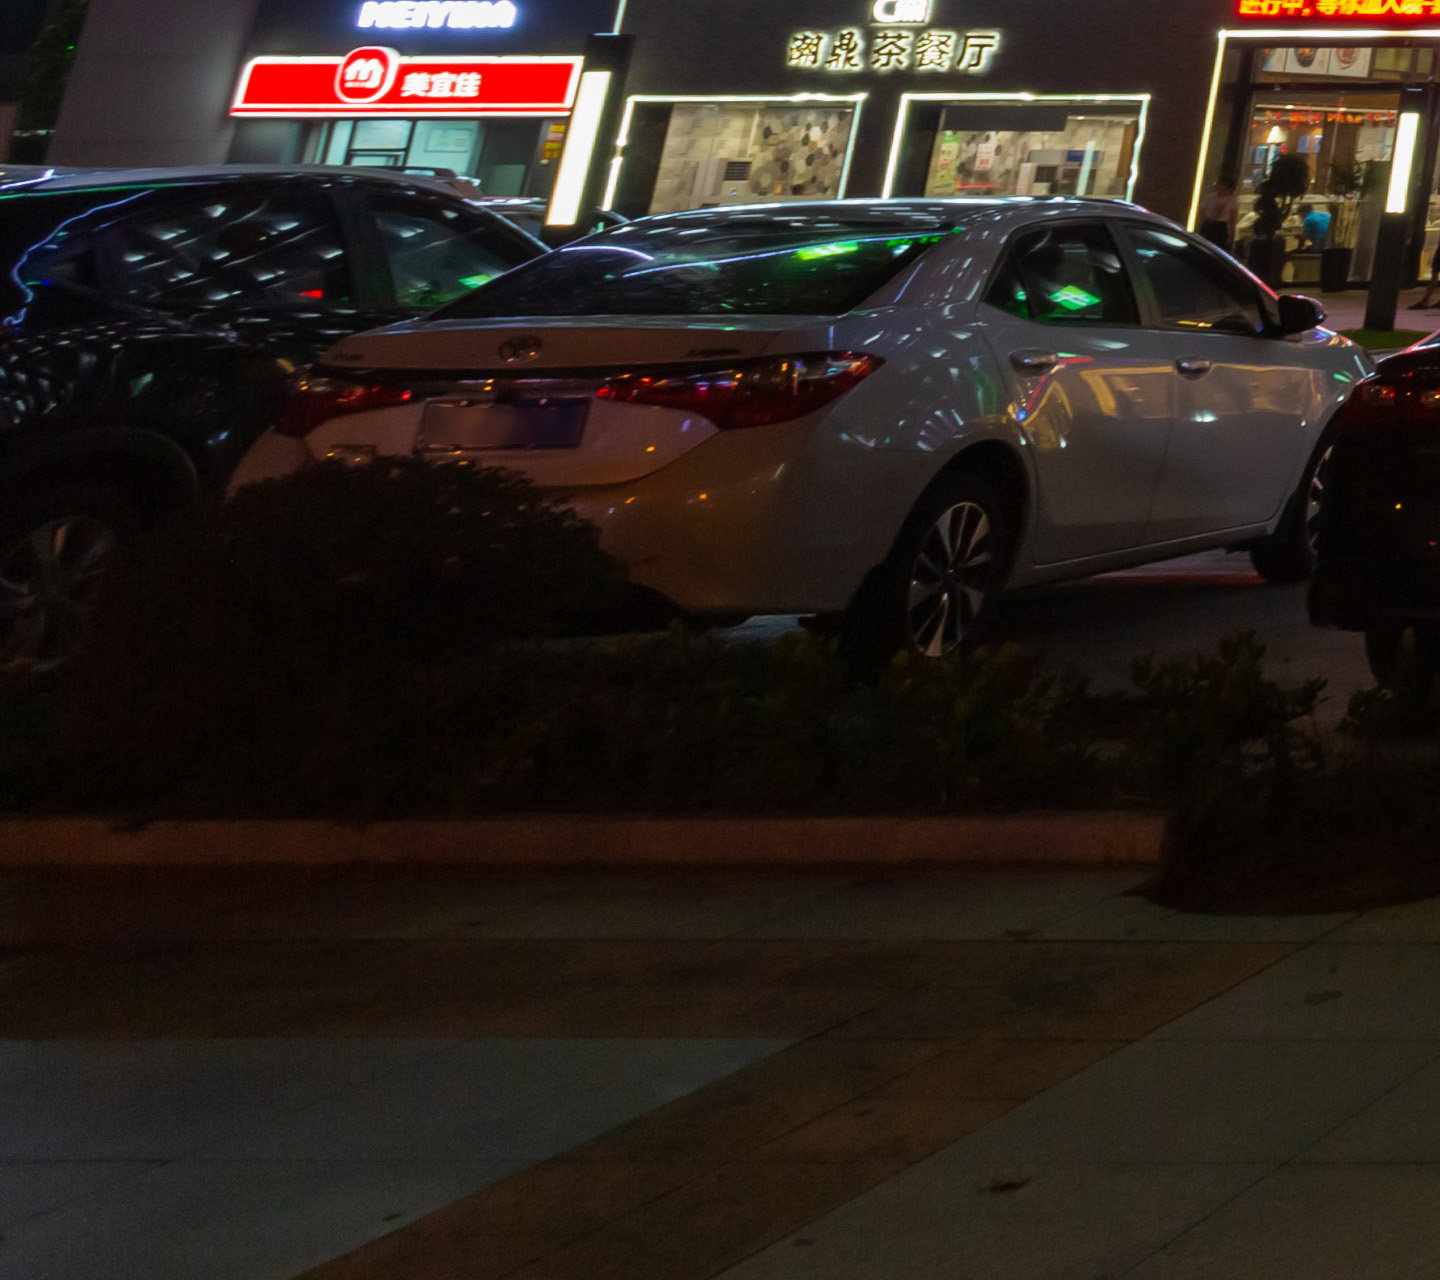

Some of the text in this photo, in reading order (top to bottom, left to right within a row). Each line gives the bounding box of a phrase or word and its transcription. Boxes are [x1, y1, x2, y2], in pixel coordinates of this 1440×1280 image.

[787, 29, 1001, 71] 潮鼎茶餐厅
[400, 71, 482, 98] 美宜佳
